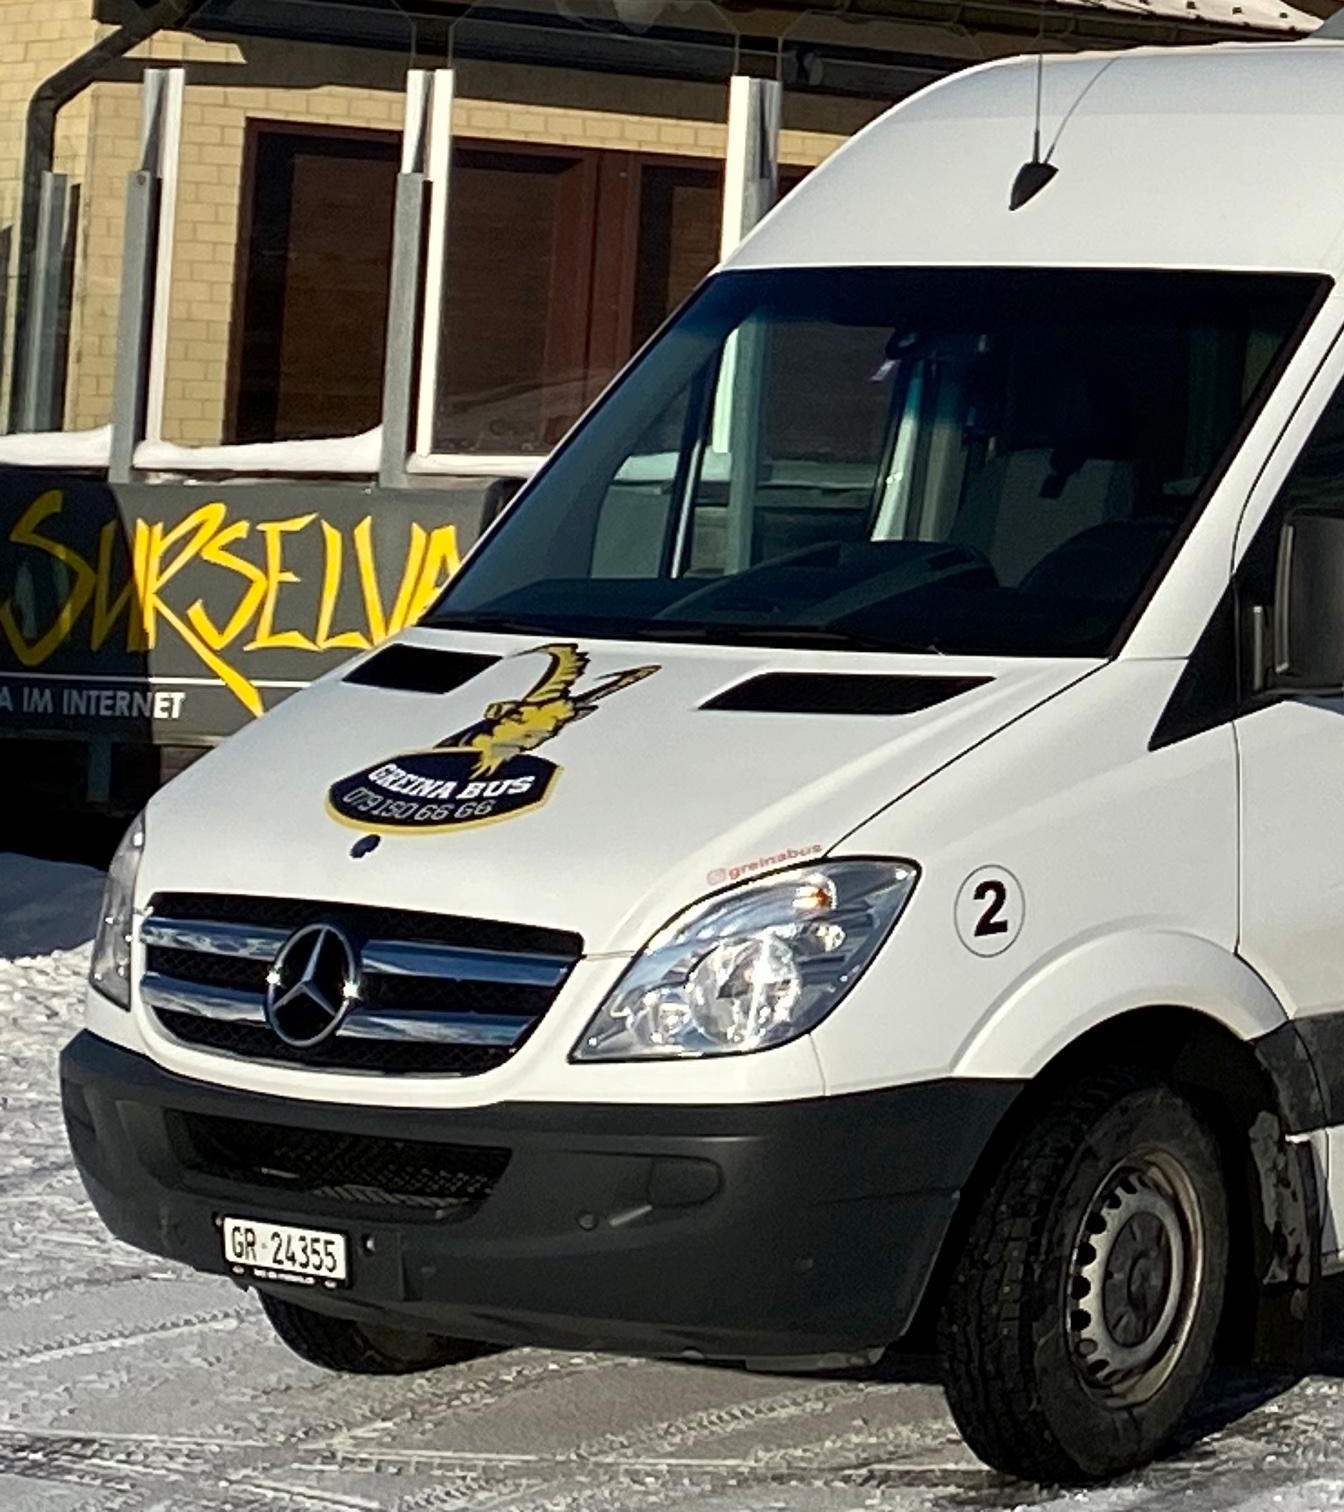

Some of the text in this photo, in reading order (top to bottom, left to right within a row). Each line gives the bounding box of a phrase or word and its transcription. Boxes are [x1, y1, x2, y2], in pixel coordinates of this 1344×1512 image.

[22, 687, 53, 714] IM
[63, 689, 186, 719] INTERNET
[368, 763, 536, 800] GREINA BUS
[342, 786, 497, 821] 079 150 66 66
[972, 880, 1008, 937] 2
[231, 1226, 338, 1273] GR 24355
